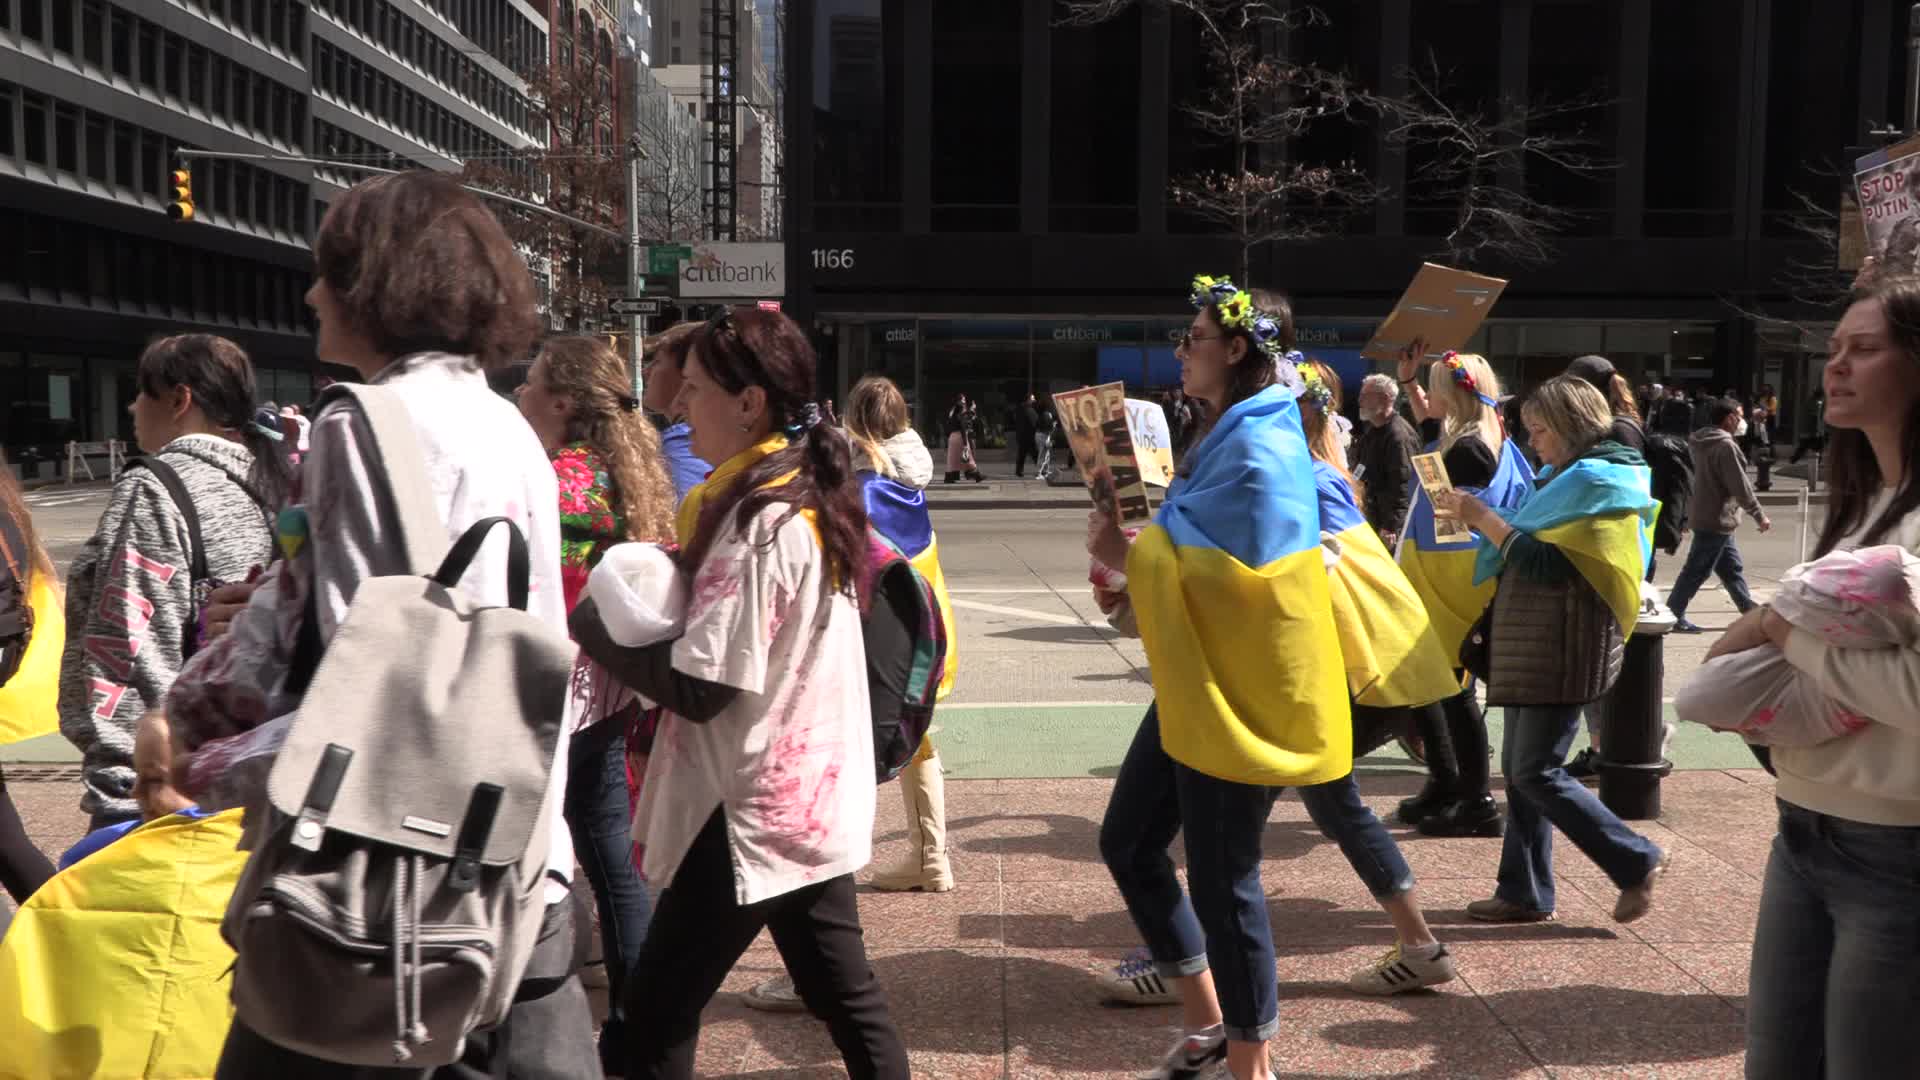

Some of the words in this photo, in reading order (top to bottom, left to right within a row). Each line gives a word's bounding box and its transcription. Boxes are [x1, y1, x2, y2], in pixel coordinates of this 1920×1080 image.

[1861, 171, 1905, 199] STOP
[1865, 196, 1909, 220] PUTIN
[811, 248, 855, 270] 1166
[685, 260, 777, 283] citibank
[1053, 325, 1113, 342] citibank
